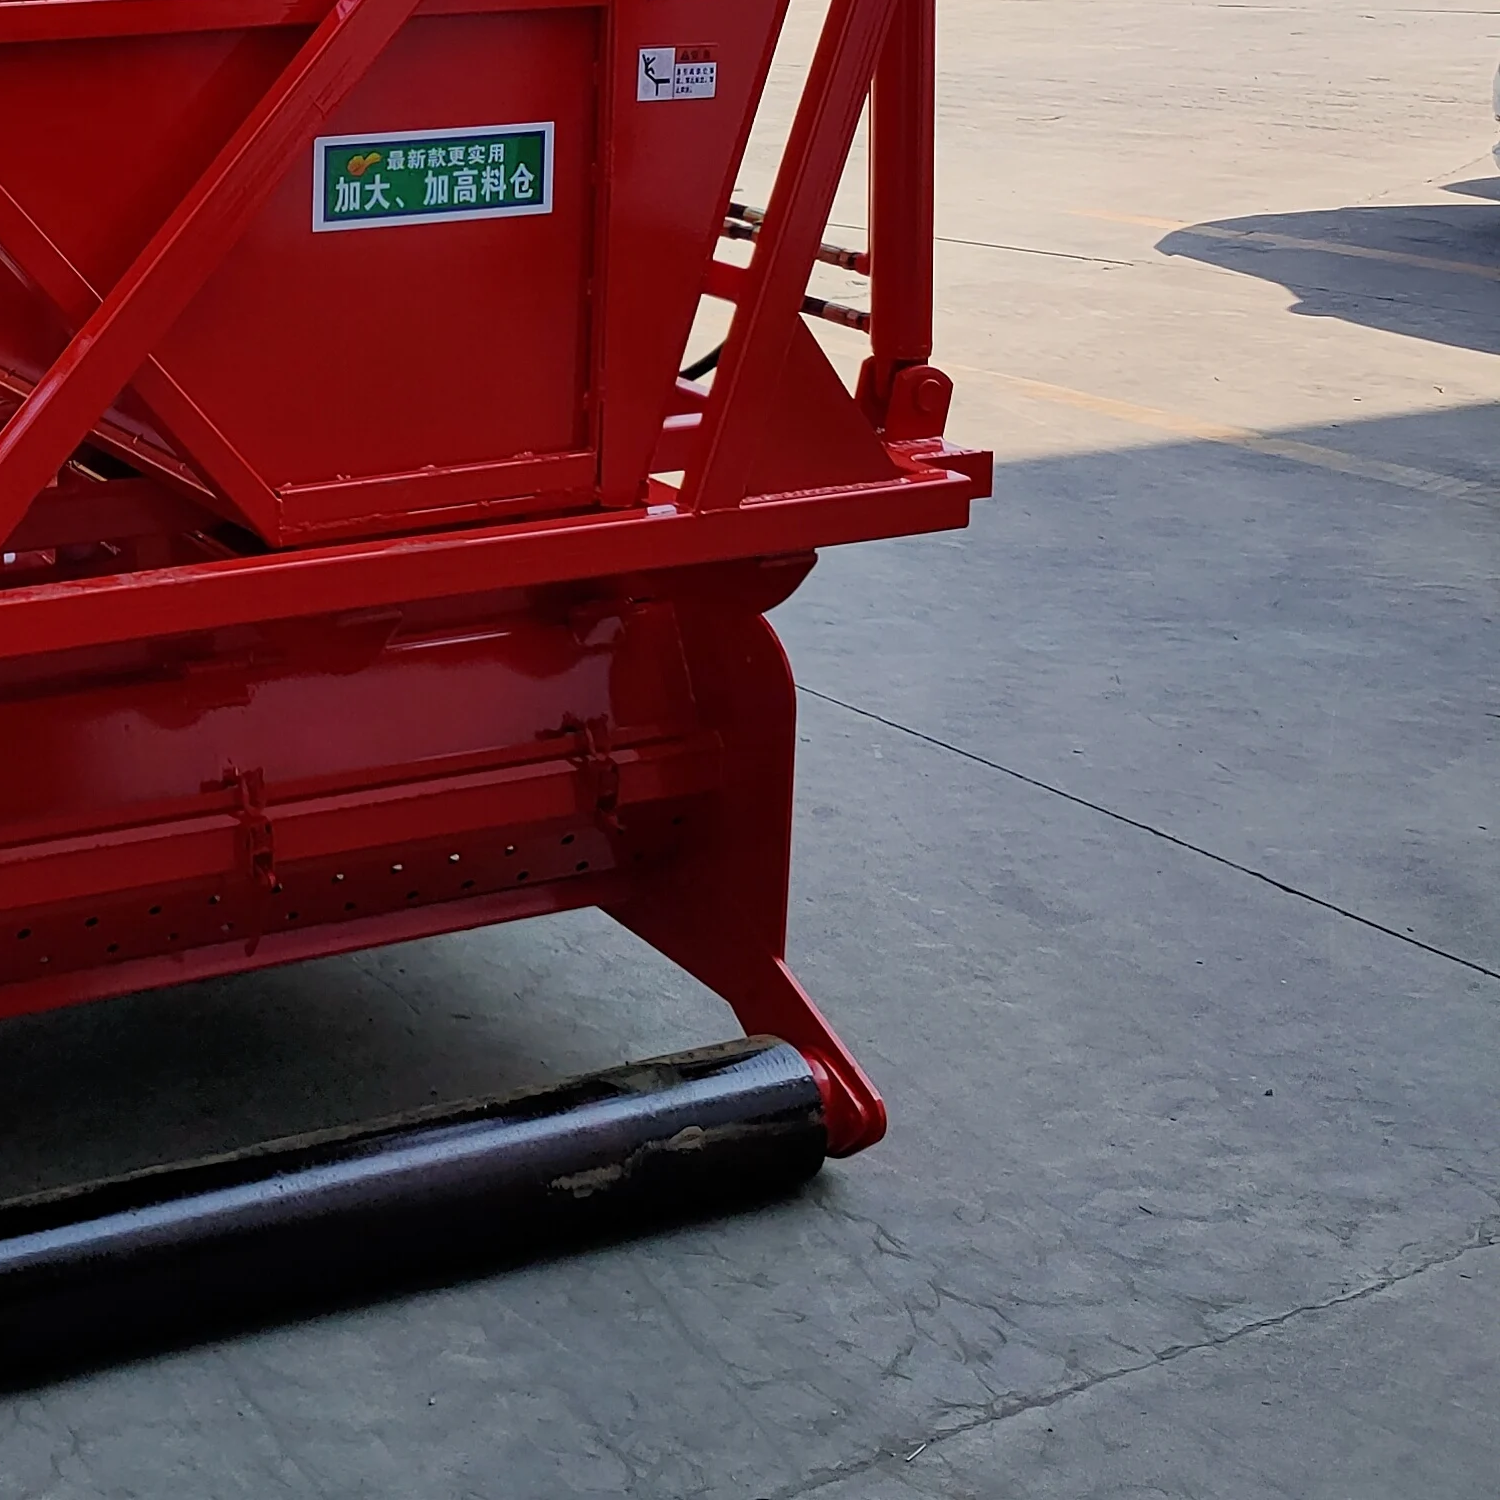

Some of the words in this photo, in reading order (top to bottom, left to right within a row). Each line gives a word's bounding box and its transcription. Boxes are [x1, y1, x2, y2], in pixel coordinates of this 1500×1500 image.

[386, 143, 505, 171] 最新款更实用
